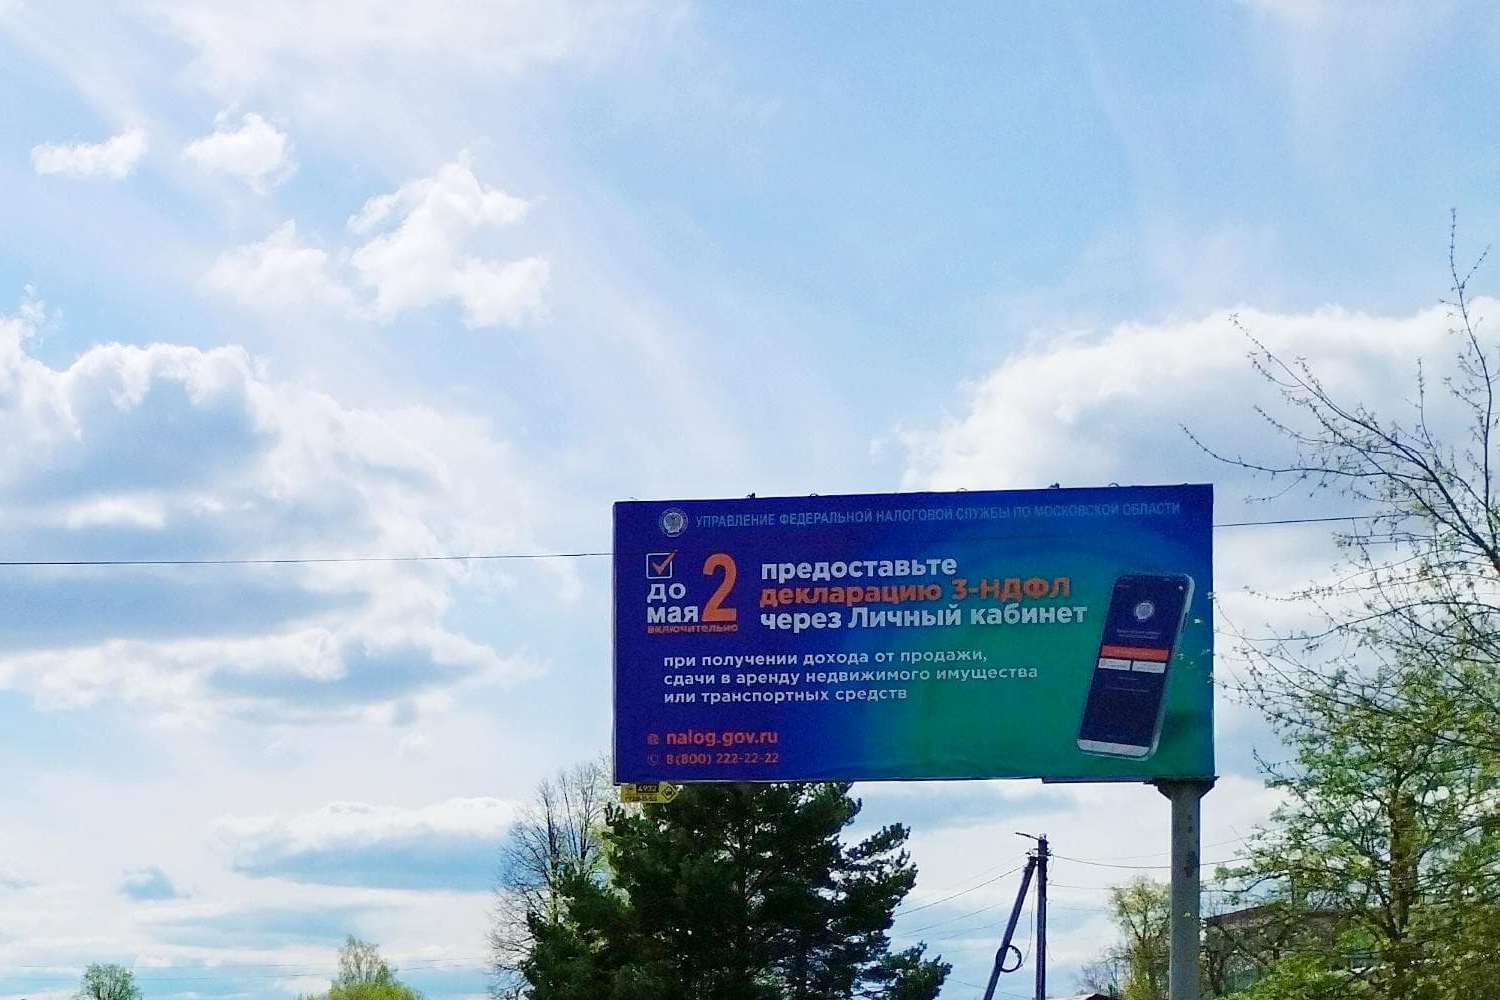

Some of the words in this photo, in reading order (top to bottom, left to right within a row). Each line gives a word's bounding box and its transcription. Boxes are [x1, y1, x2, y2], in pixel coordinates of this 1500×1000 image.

[696, 514, 775, 528] УПРАВЛЕНИЕ
[779, 509, 873, 526] ФЕДЕРАЛЬНОЙ
[876, 506, 953, 522] НАЛОГОВОЙ
[956, 506, 1010, 521] СЛУЖБЫ
[1013, 505, 1031, 518] ПО
[1034, 502, 1120, 518] МОСКОВСКОЙ
[1122, 502, 1181, 516] ОБЛАСТИ
[761, 558, 958, 583] предоставьте
[647, 583, 686, 602] до
[702, 553, 737, 622] 2
[759, 584, 942, 607] декларацию
[951, 577, 1071, 603] 3-НДФЛ
[647, 606, 698, 624] мая
[760, 611, 842, 633] через
[847, 603, 962, 628] Личный
[970, 603, 1088, 625] кабинет
[664, 655, 696, 669] при
[701, 653, 798, 668] получении
[803, 650, 869, 666] дохода
[874, 651, 895, 663] от
[900, 650, 987, 664] продажи,
[663, 673, 715, 685] сдачи
[721, 673, 730, 684] в
[736, 671, 801, 686] аренду
[806, 669, 931, 683] недвижимого
[936, 667, 1039, 682] имущества
[664, 690, 696, 703] или
[701, 688, 830, 704] транспортных
[835, 688, 908, 701] средств
[666, 729, 778, 747] nalog.gov.ru
[666, 752, 712, 766] 8(800)
[716, 752, 779, 764] 222-22-22
